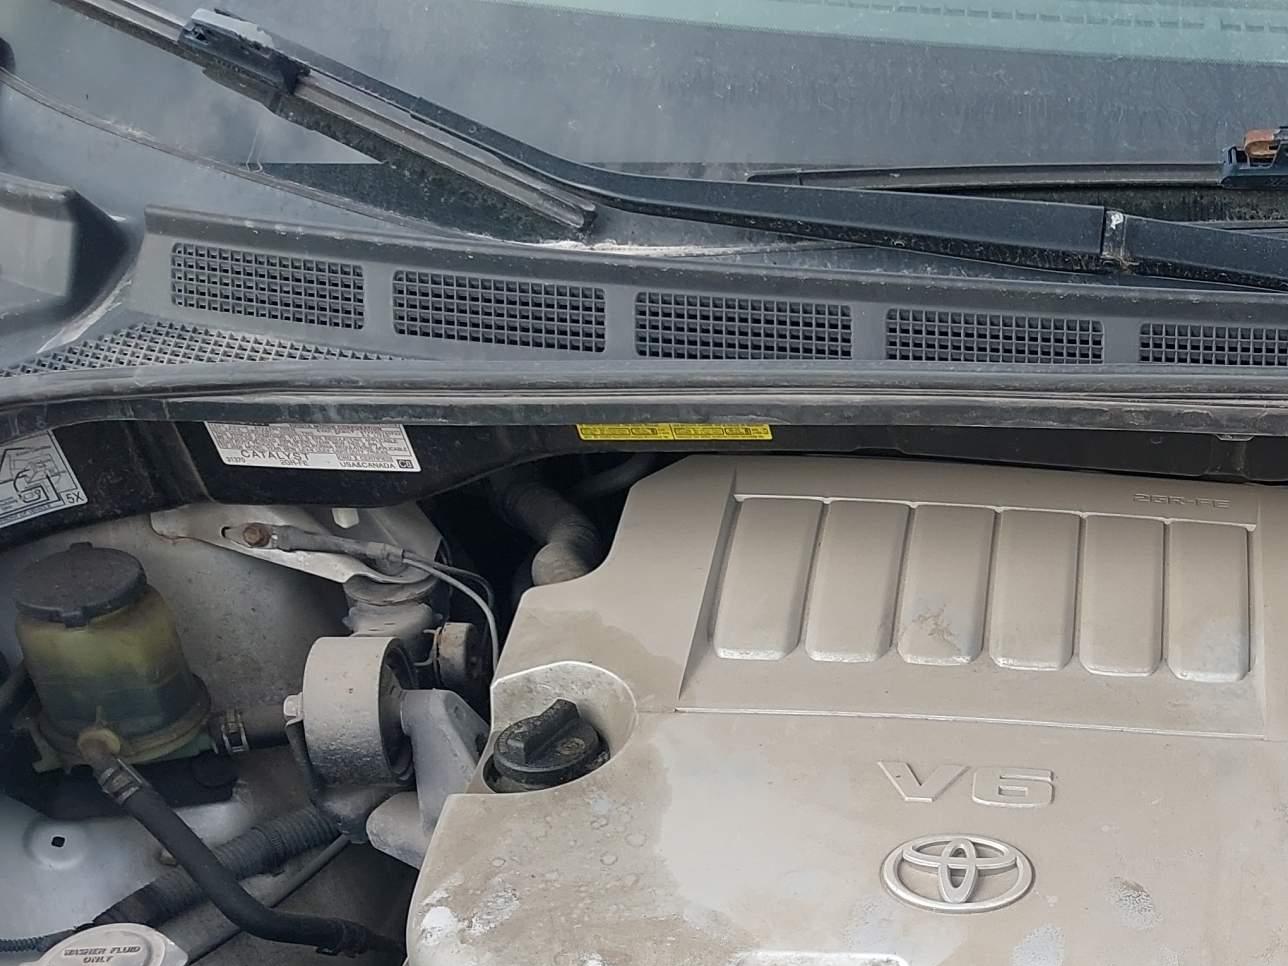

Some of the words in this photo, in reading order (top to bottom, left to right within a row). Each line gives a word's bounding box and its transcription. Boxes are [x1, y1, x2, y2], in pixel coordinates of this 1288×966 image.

[240, 449, 310, 461] CATALYST
[65, 490, 85, 504] 5X
[877, 759, 1055, 809] V6
